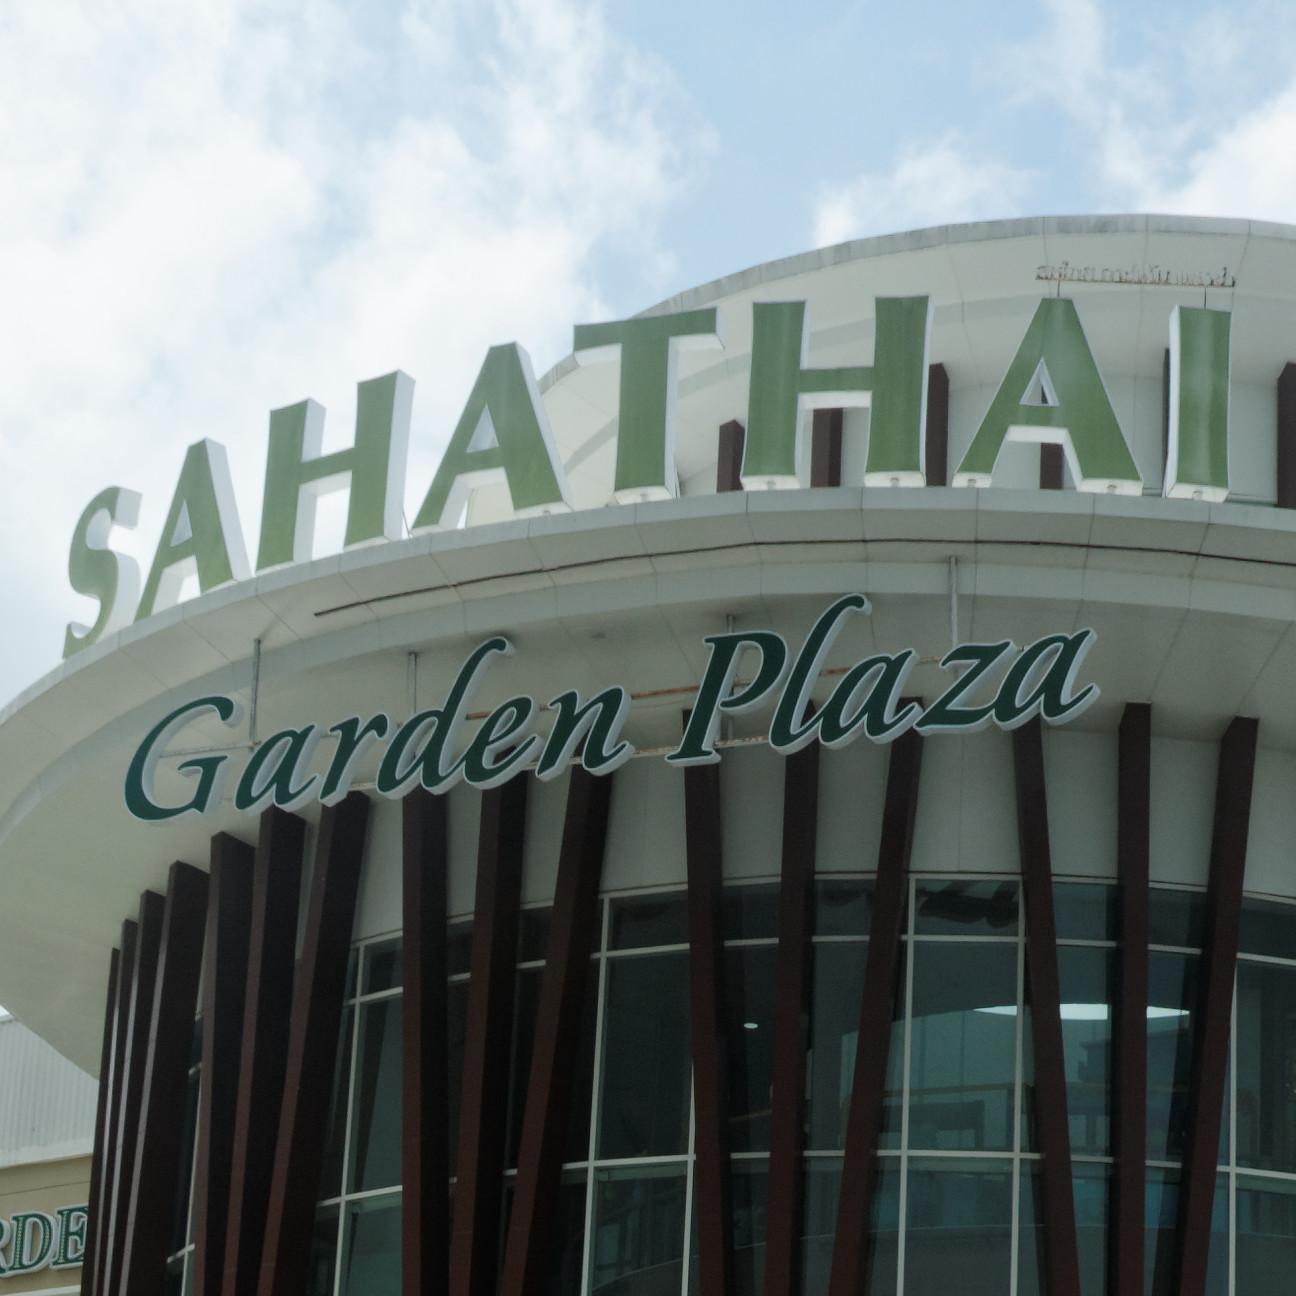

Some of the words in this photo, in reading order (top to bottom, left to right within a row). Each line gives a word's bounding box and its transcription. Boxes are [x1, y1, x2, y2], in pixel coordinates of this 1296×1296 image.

[62, 294, 1232, 658] SAHATHAI
[124, 636, 634, 823] Garden
[664, 593, 1101, 767] Plaza
